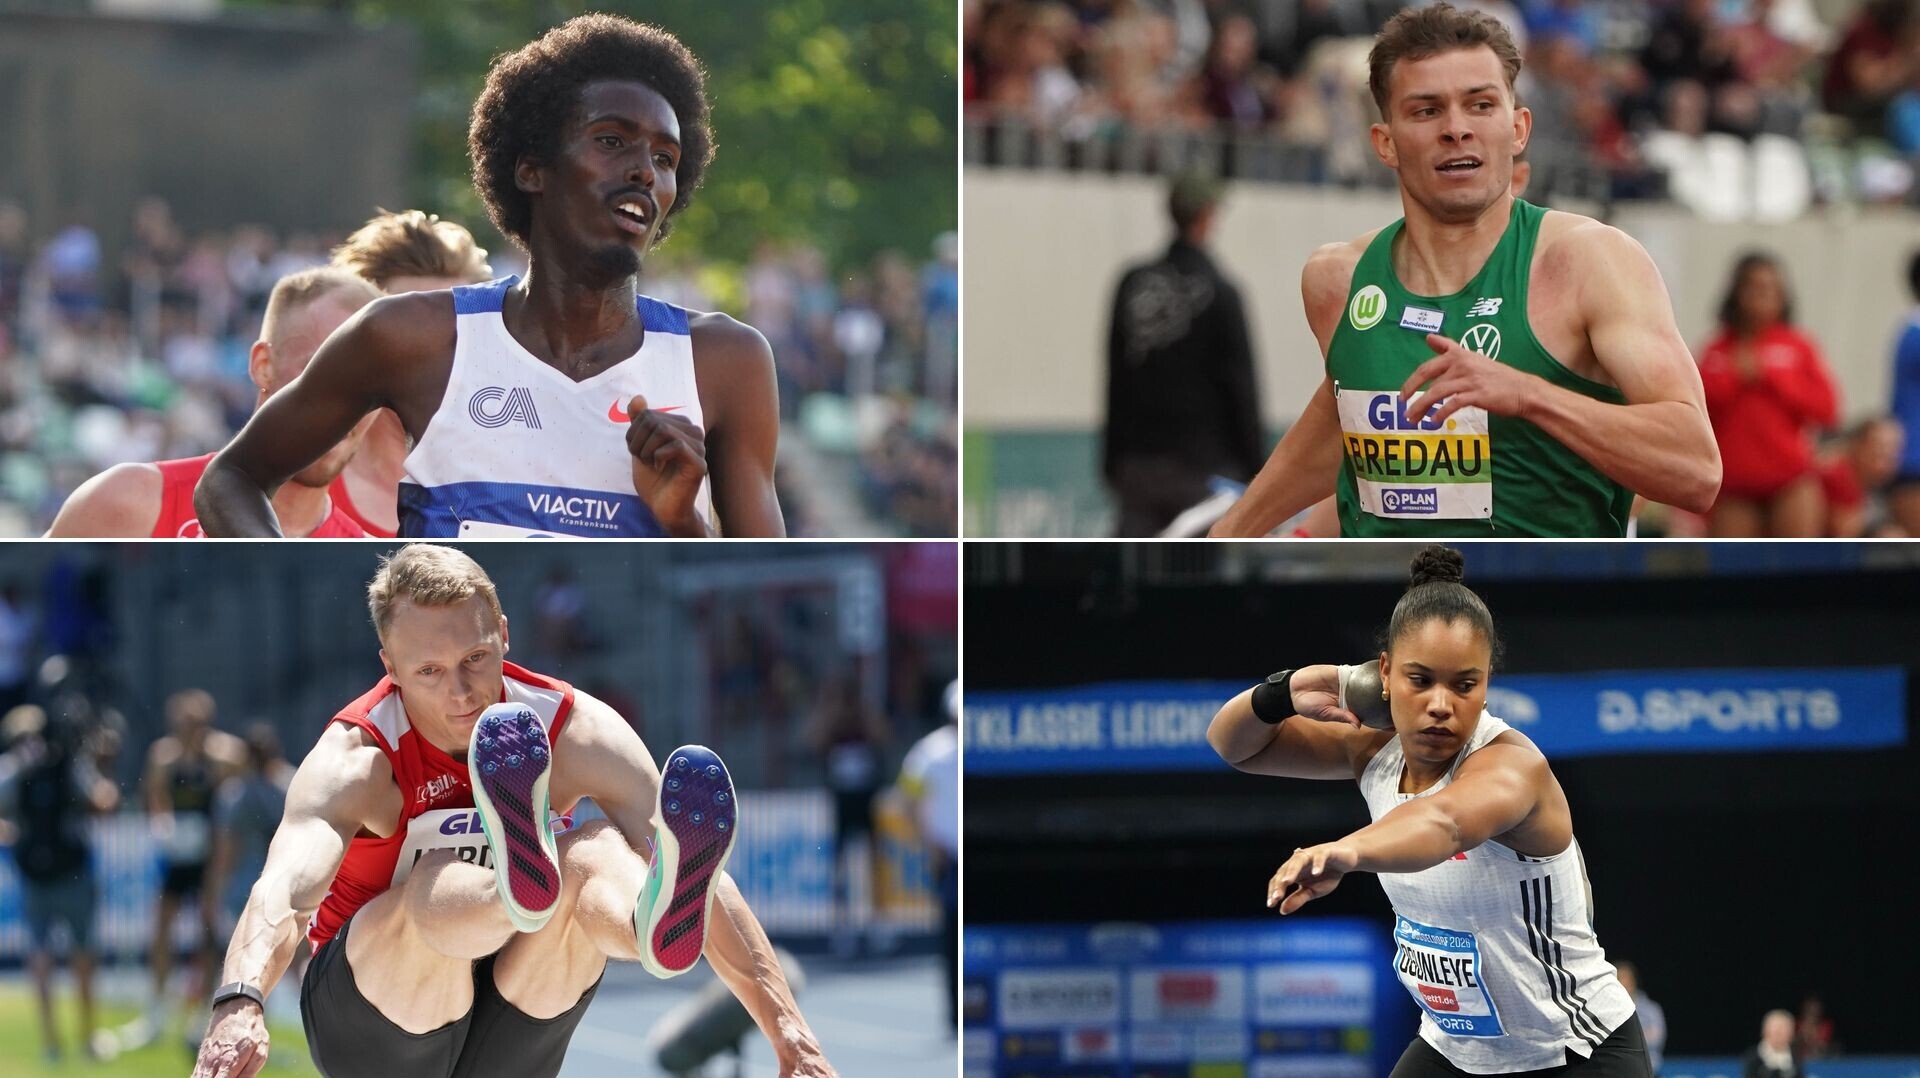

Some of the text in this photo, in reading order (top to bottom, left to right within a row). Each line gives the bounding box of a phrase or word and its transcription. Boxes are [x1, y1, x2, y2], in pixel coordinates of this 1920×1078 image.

[1402, 319, 1438, 331] Bundeswehr
[468, 386, 543, 430] CA
[1349, 436, 1482, 477] BREDAU
[527, 492, 621, 521] VIACTIV
[1401, 492, 1435, 505] PLAN
[559, 517, 619, 530] Krankenkasse
[1596, 688, 1842, 733] D.SPORTS
[439, 812, 485, 836] GL
[1449, 936, 1471, 948] 2026
